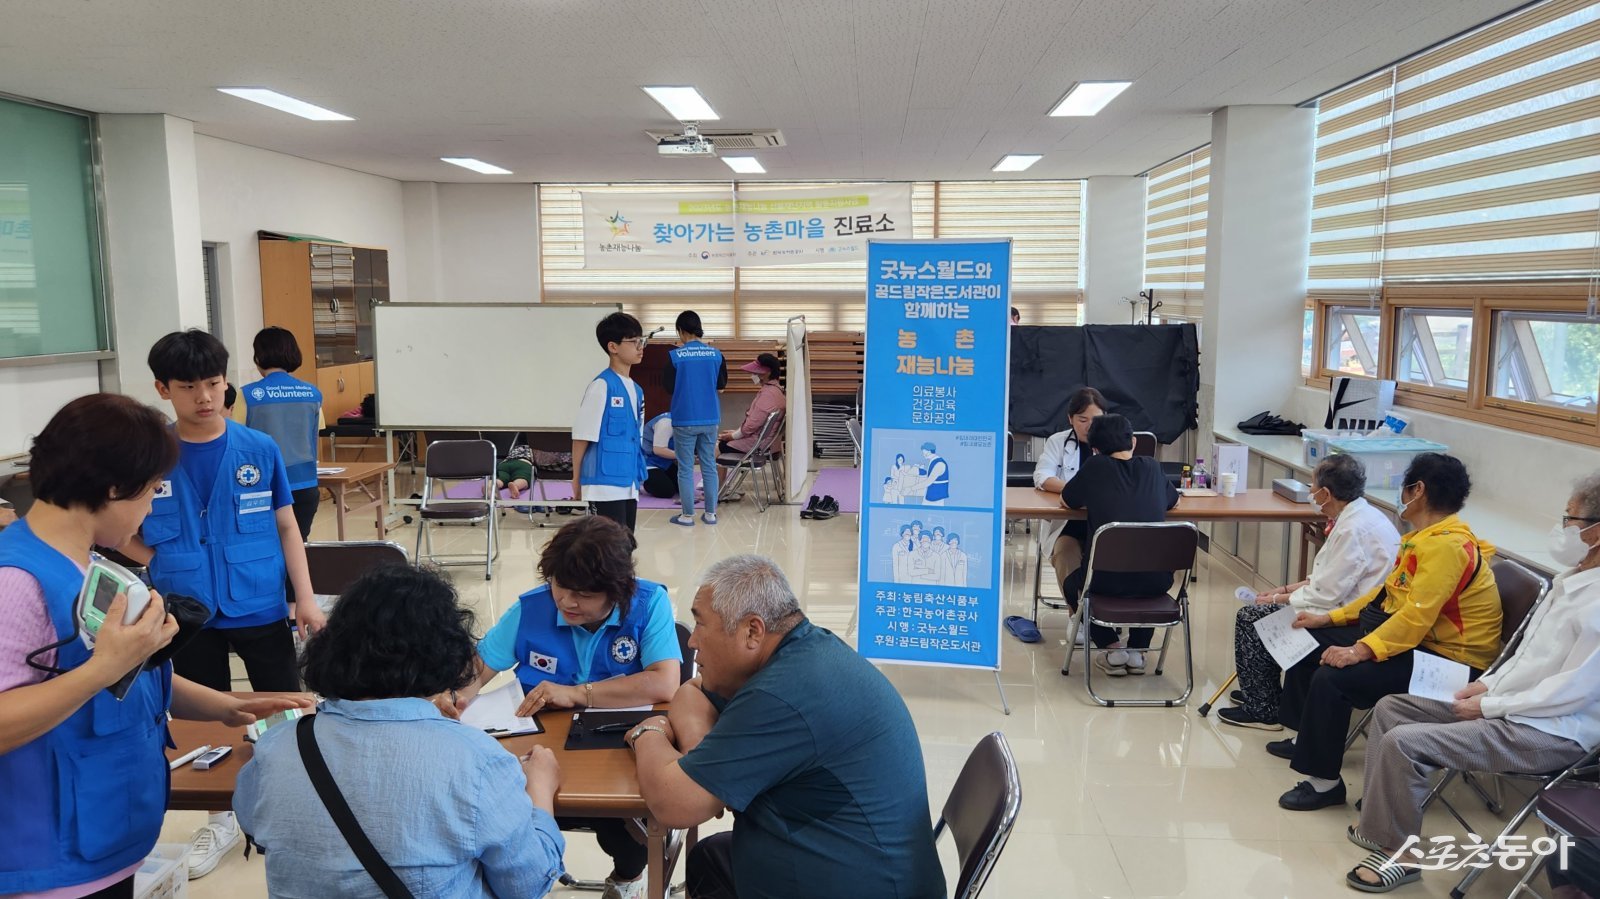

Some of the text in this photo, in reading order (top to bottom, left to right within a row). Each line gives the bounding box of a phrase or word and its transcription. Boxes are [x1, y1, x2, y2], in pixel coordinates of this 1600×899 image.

[653, 213, 896, 243] 찾아가는 농촌마을 진료소
[599, 243, 642, 253] 농촌재능나눔
[880, 260, 992, 280] 굿뉴스월드와
[875, 284, 1000, 300] 꿈드림작은도서관이
[904, 302, 970, 319] 함께하는
[676, 350, 716, 358] Volunteers
[896, 355, 975, 376] 재능나눔
[266, 390, 314, 399] Volunteers
[912, 385, 957, 398] 의료봉사
[912, 399, 956, 411] 건강교육
[912, 412, 956, 425] 문화공연
